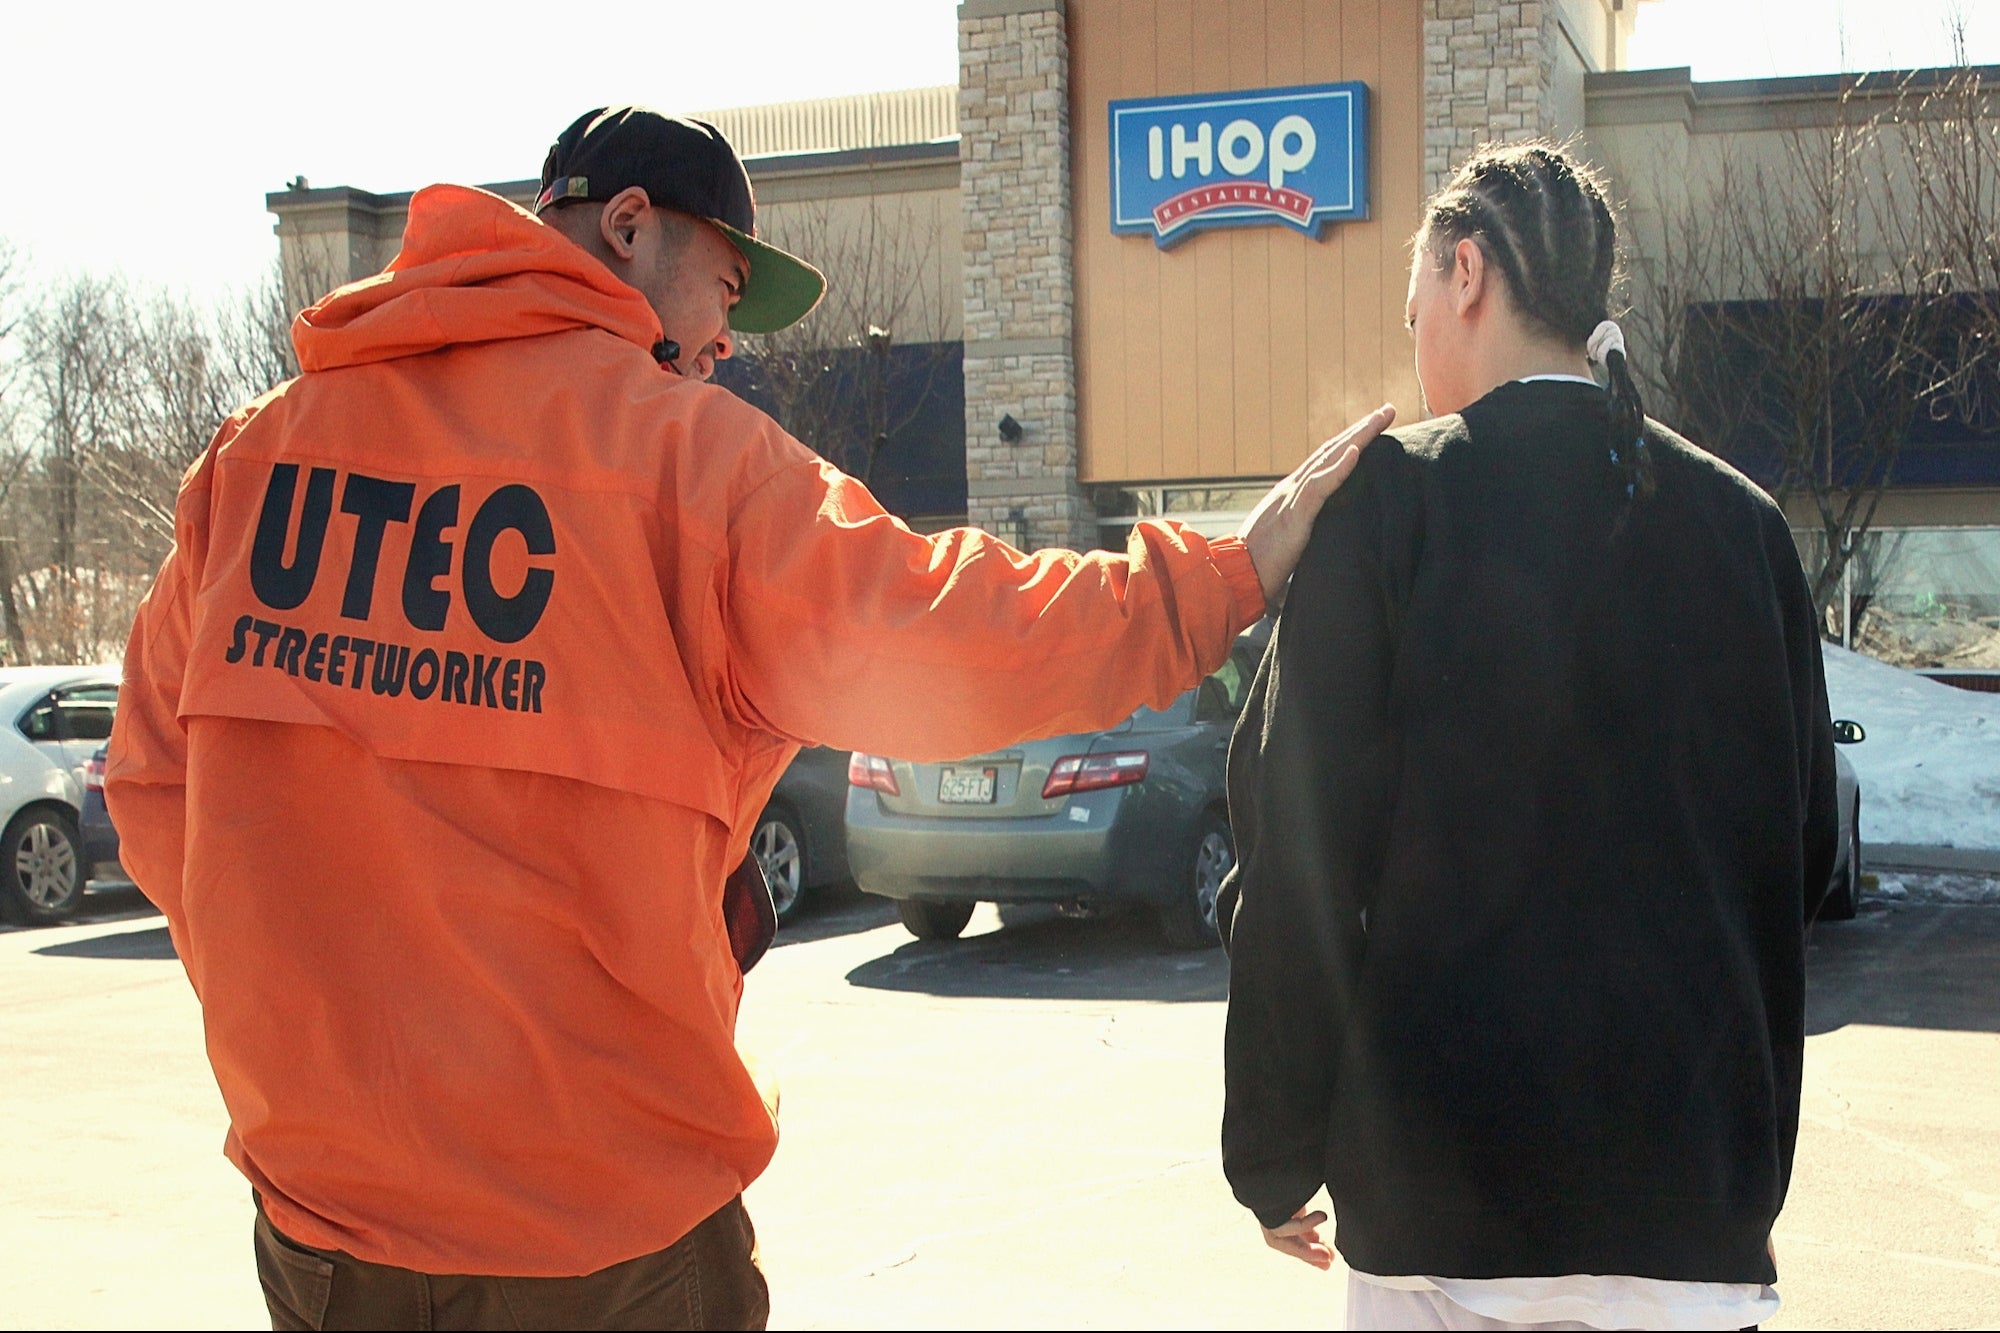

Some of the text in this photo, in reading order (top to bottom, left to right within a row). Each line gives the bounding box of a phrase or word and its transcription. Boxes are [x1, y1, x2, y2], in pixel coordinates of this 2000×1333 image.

[1149, 115, 1316, 189] IHOP
[1162, 189, 1301, 219] RESTAURANT
[250, 463, 557, 644] UTEC
[225, 615, 546, 714] STREETWORKER
